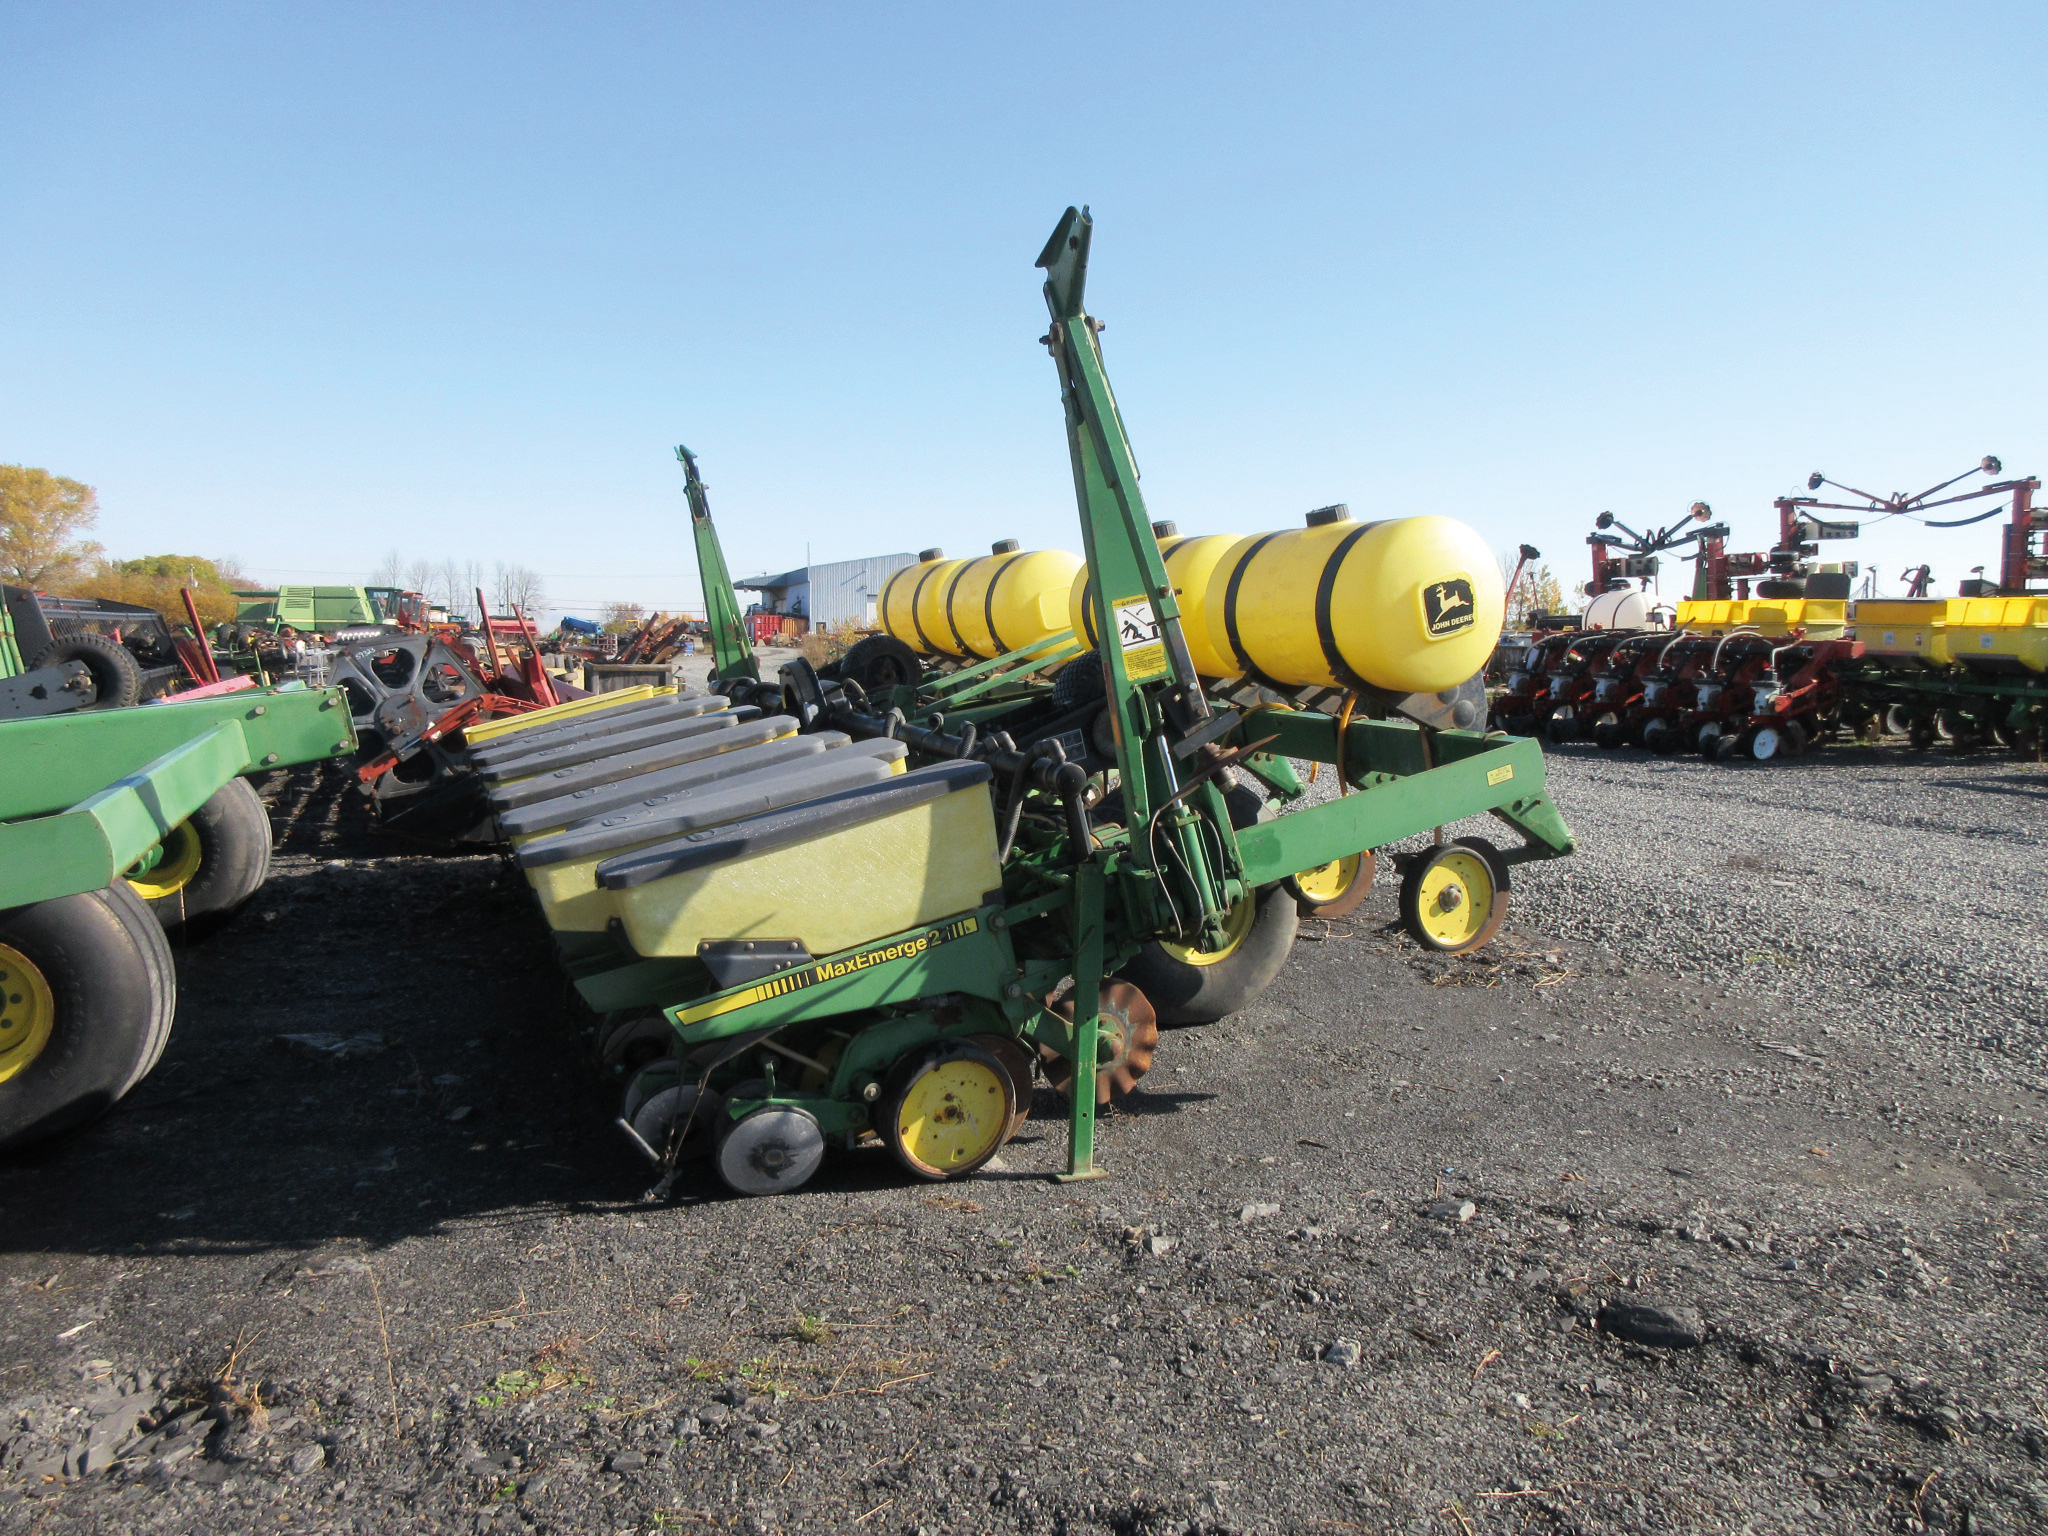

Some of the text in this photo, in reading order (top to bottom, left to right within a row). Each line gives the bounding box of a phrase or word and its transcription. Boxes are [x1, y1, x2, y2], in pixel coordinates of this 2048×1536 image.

[1432, 614, 1473, 631] JOHN DEERE
[815, 930, 942, 983] MaxEmerge 2
